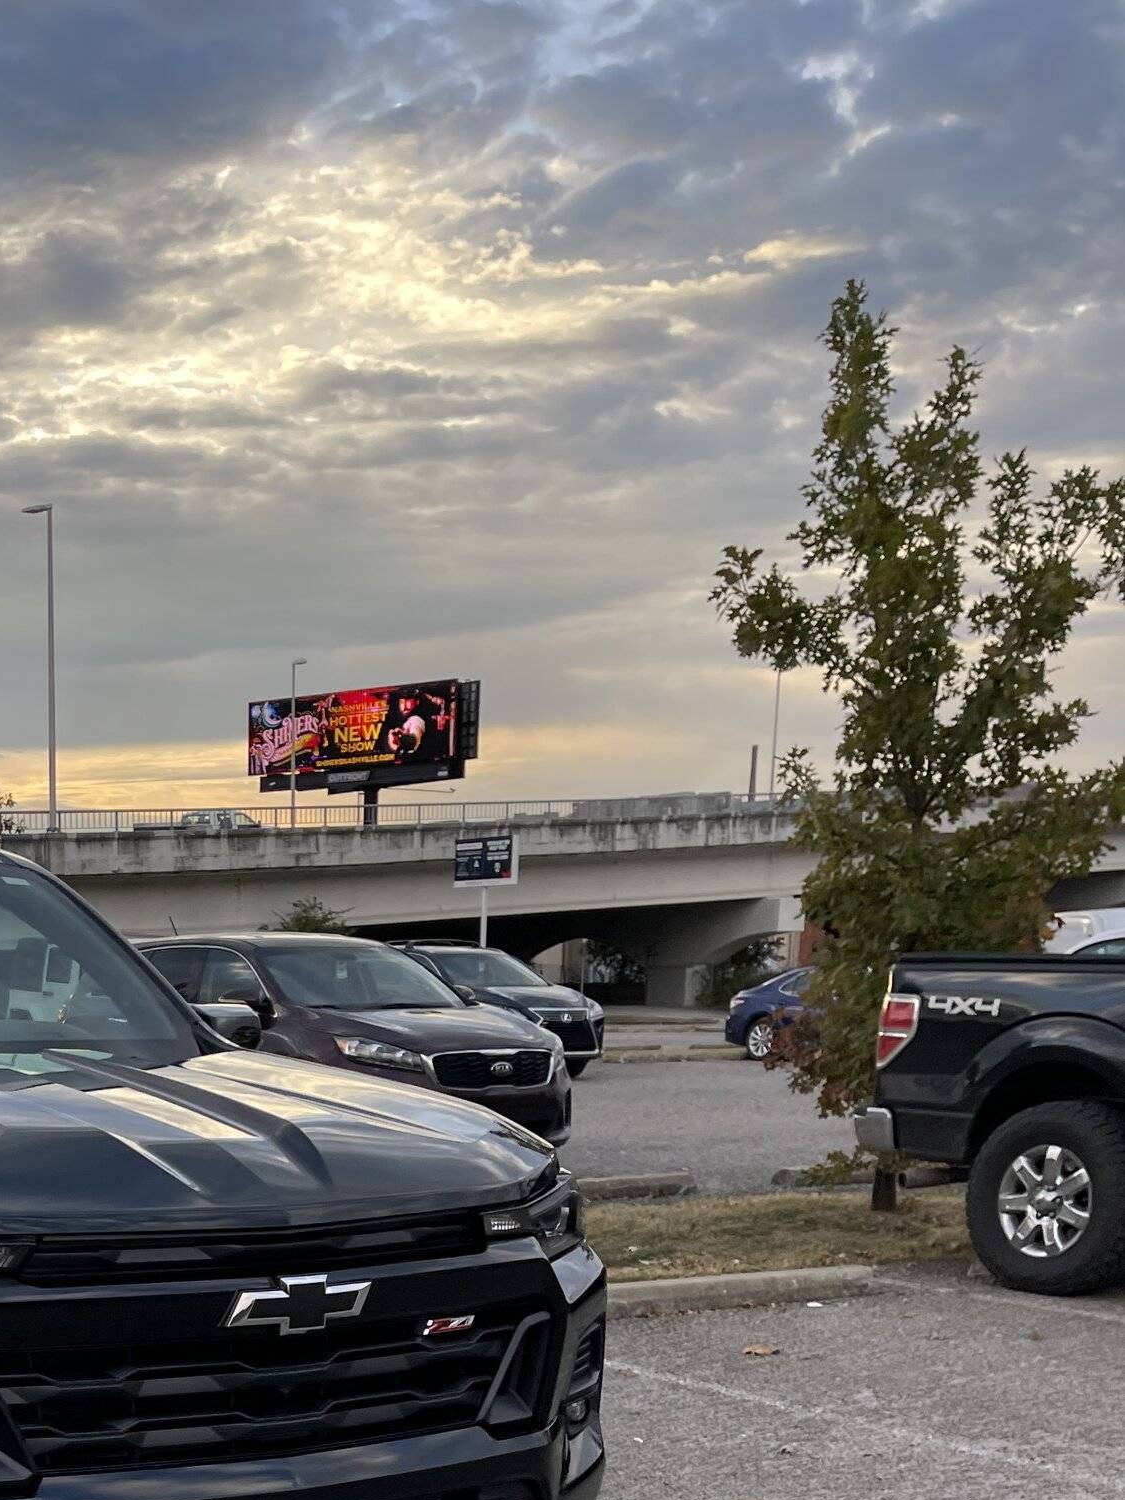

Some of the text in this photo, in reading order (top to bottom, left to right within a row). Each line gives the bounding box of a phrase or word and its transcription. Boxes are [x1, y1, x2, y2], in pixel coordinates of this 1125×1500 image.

[329, 711, 388, 727] HOTTEST
[334, 723, 382, 743] NEW
[340, 740, 375, 753] SHOW
